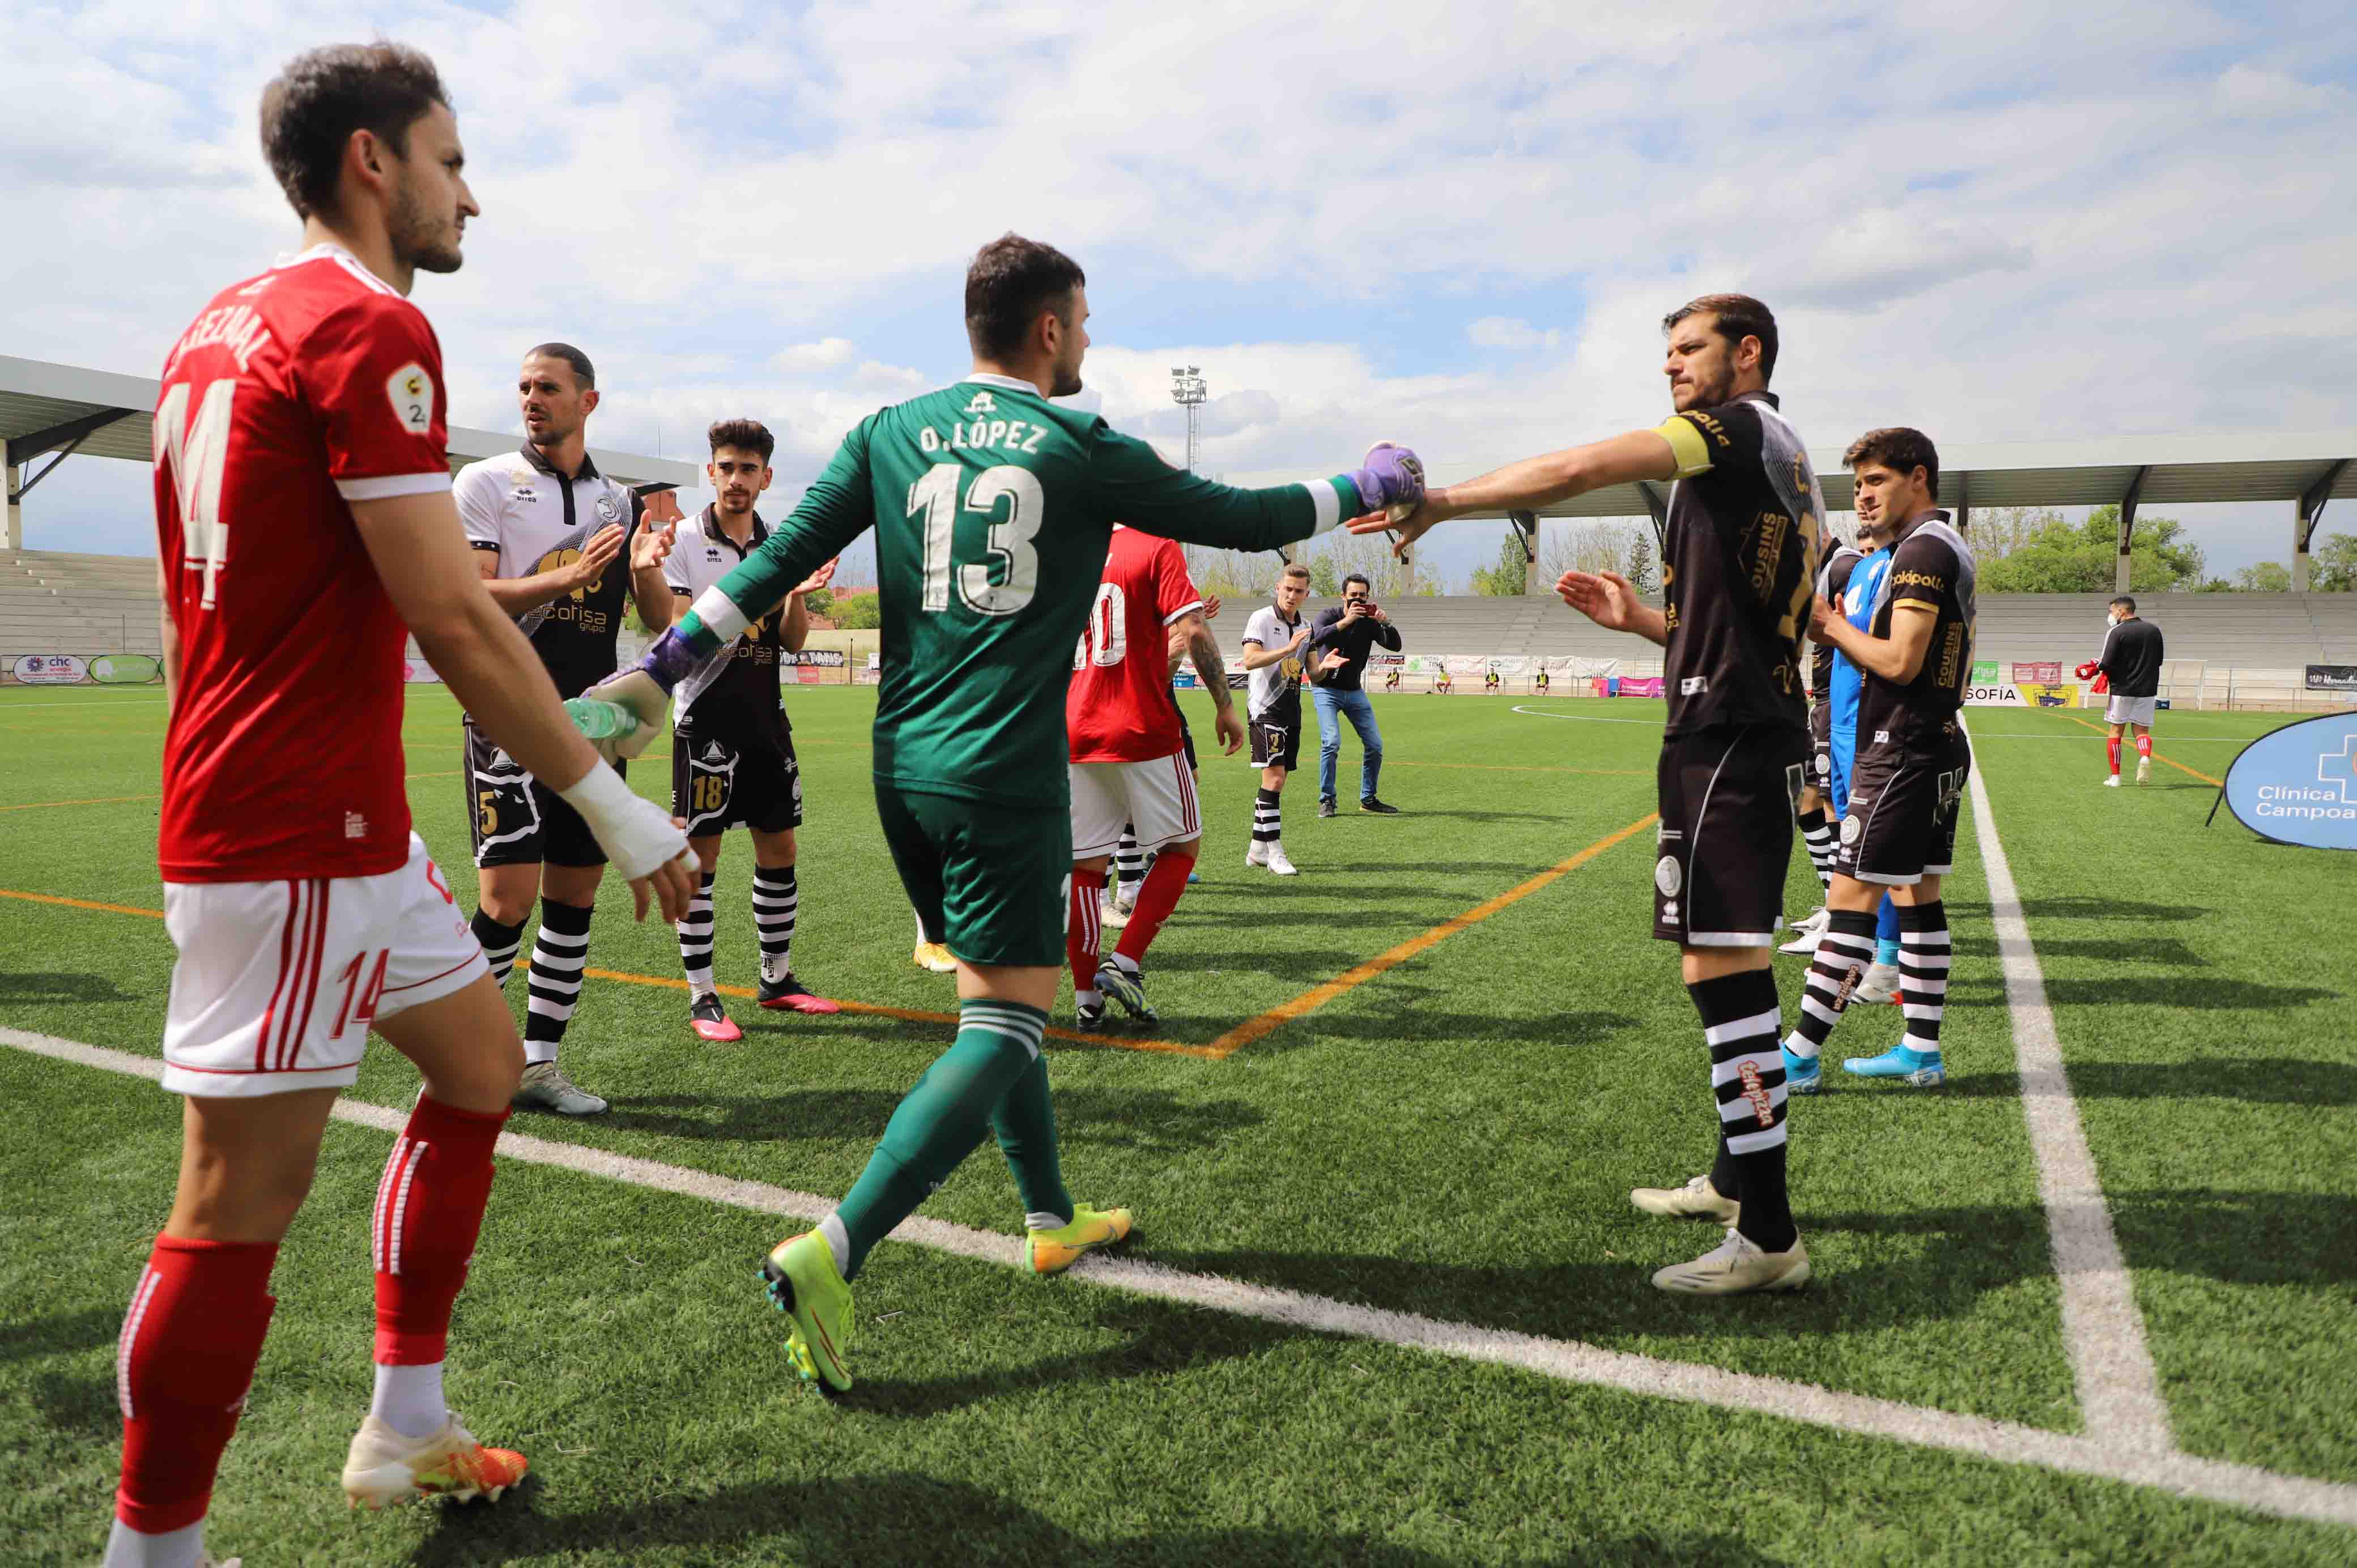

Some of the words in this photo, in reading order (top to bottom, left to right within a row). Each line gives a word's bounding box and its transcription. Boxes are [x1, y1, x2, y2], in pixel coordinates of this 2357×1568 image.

[154, 378, 236, 610] 14
[907, 463, 1044, 616] 13
[50, 656, 70, 667] chc
[477, 791, 498, 834] 5
[693, 775, 722, 810] 18
[2258, 785, 2335, 801] Clínica
[328, 948, 389, 1039] 14
[1738, 1060, 1773, 1127] telepizza
